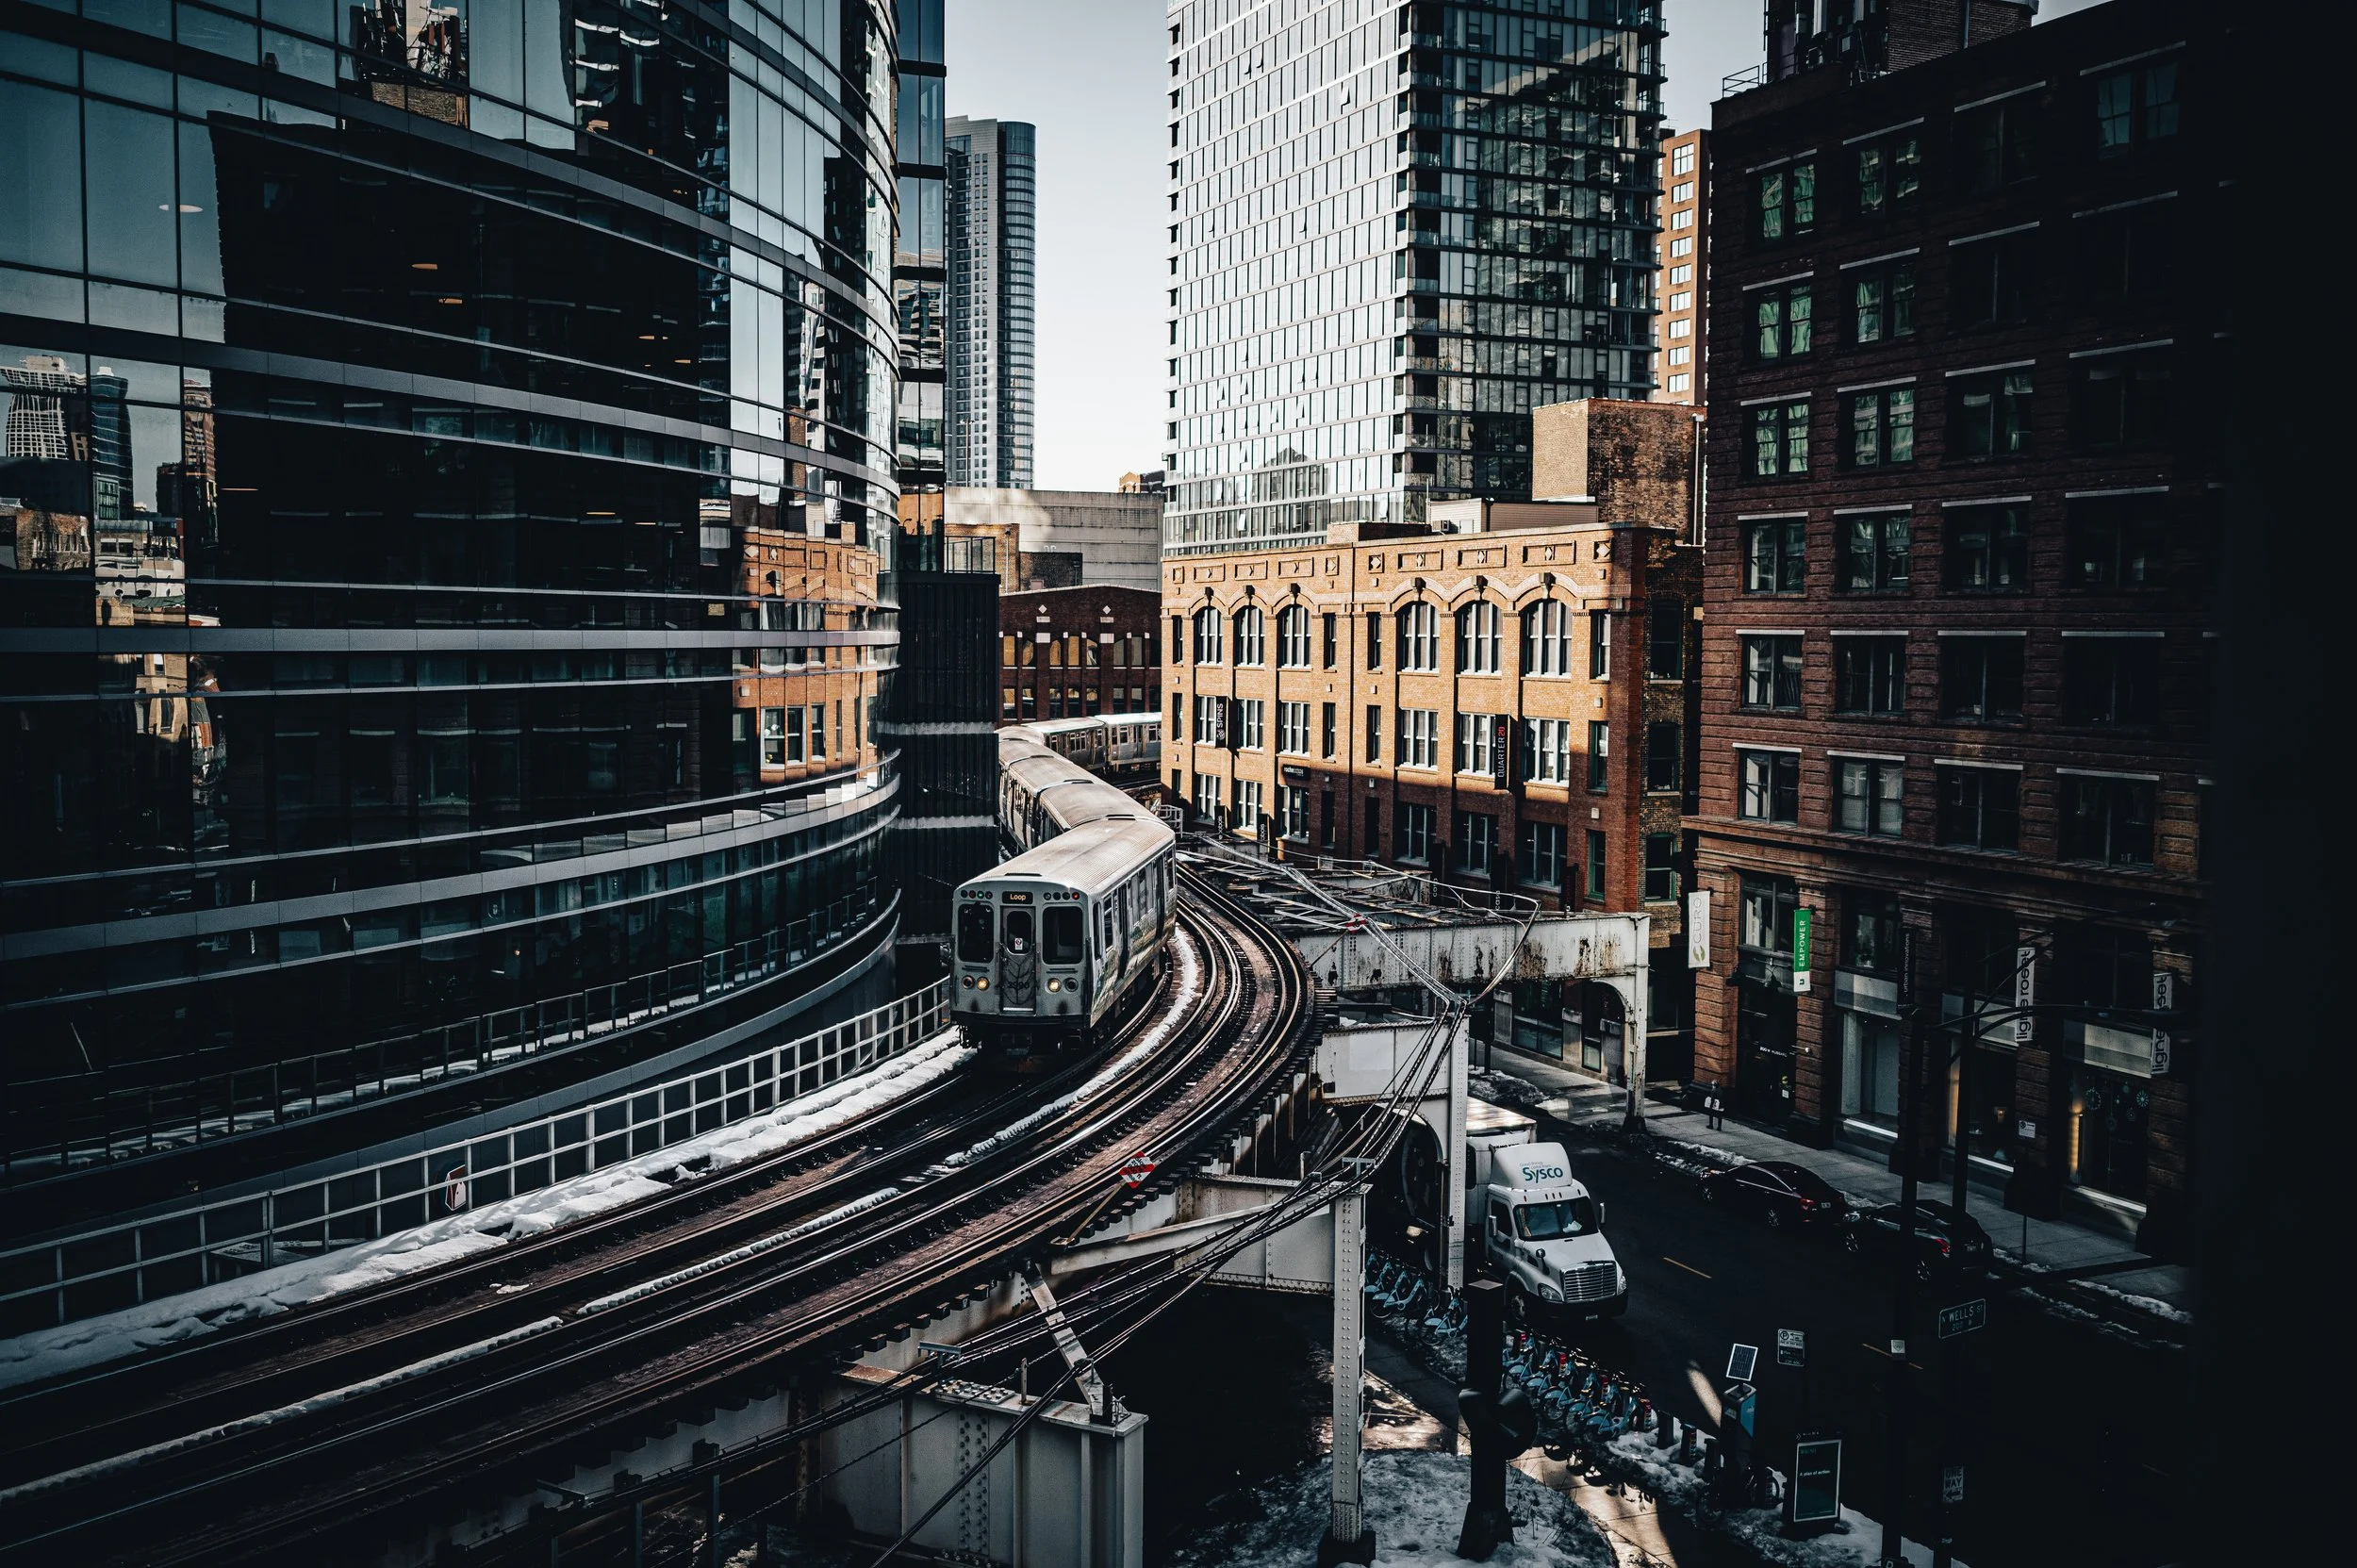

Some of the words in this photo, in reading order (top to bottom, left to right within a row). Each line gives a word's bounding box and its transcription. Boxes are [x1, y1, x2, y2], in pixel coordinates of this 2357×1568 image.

[1693, 898, 1702, 944] CURO
[2016, 999, 2032, 1039] lige
[1522, 1166, 1563, 1183] Sysco
[1949, 1306, 1974, 1323] WELLS
[1945, 1468, 1962, 1478] ONE
[1945, 1477, 1962, 1488] WAY
